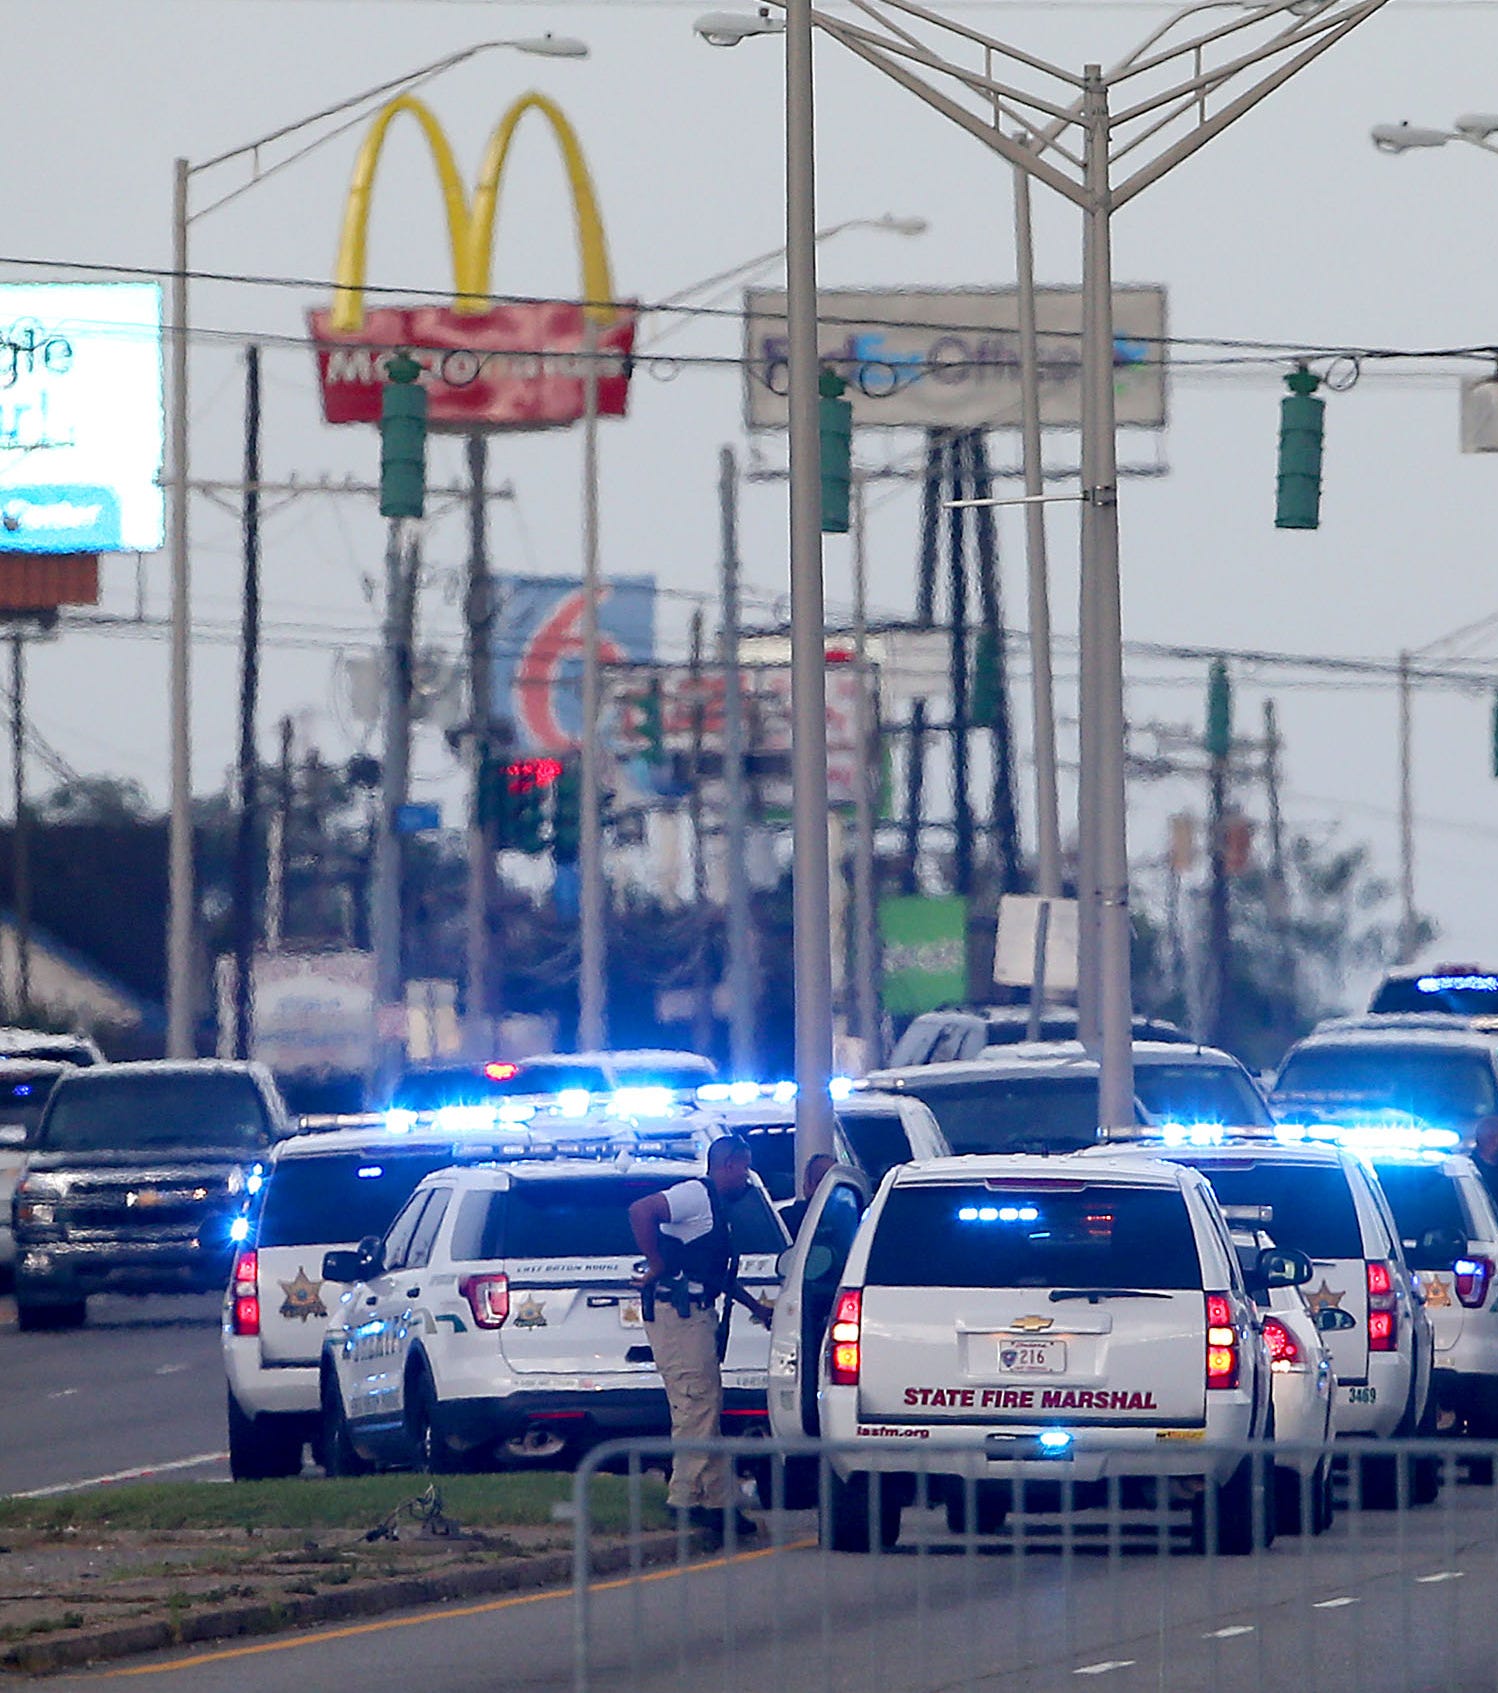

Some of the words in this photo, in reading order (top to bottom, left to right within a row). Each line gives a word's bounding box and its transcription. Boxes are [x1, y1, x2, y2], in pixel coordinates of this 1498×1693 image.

[1020, 1349, 1045, 1364] 216
[903, 1387, 974, 1408] STATE
[981, 1388, 1034, 1409] FIRE
[1041, 1390, 1158, 1411] MARSHAL
[1348, 1387, 1377, 1404] 3469
